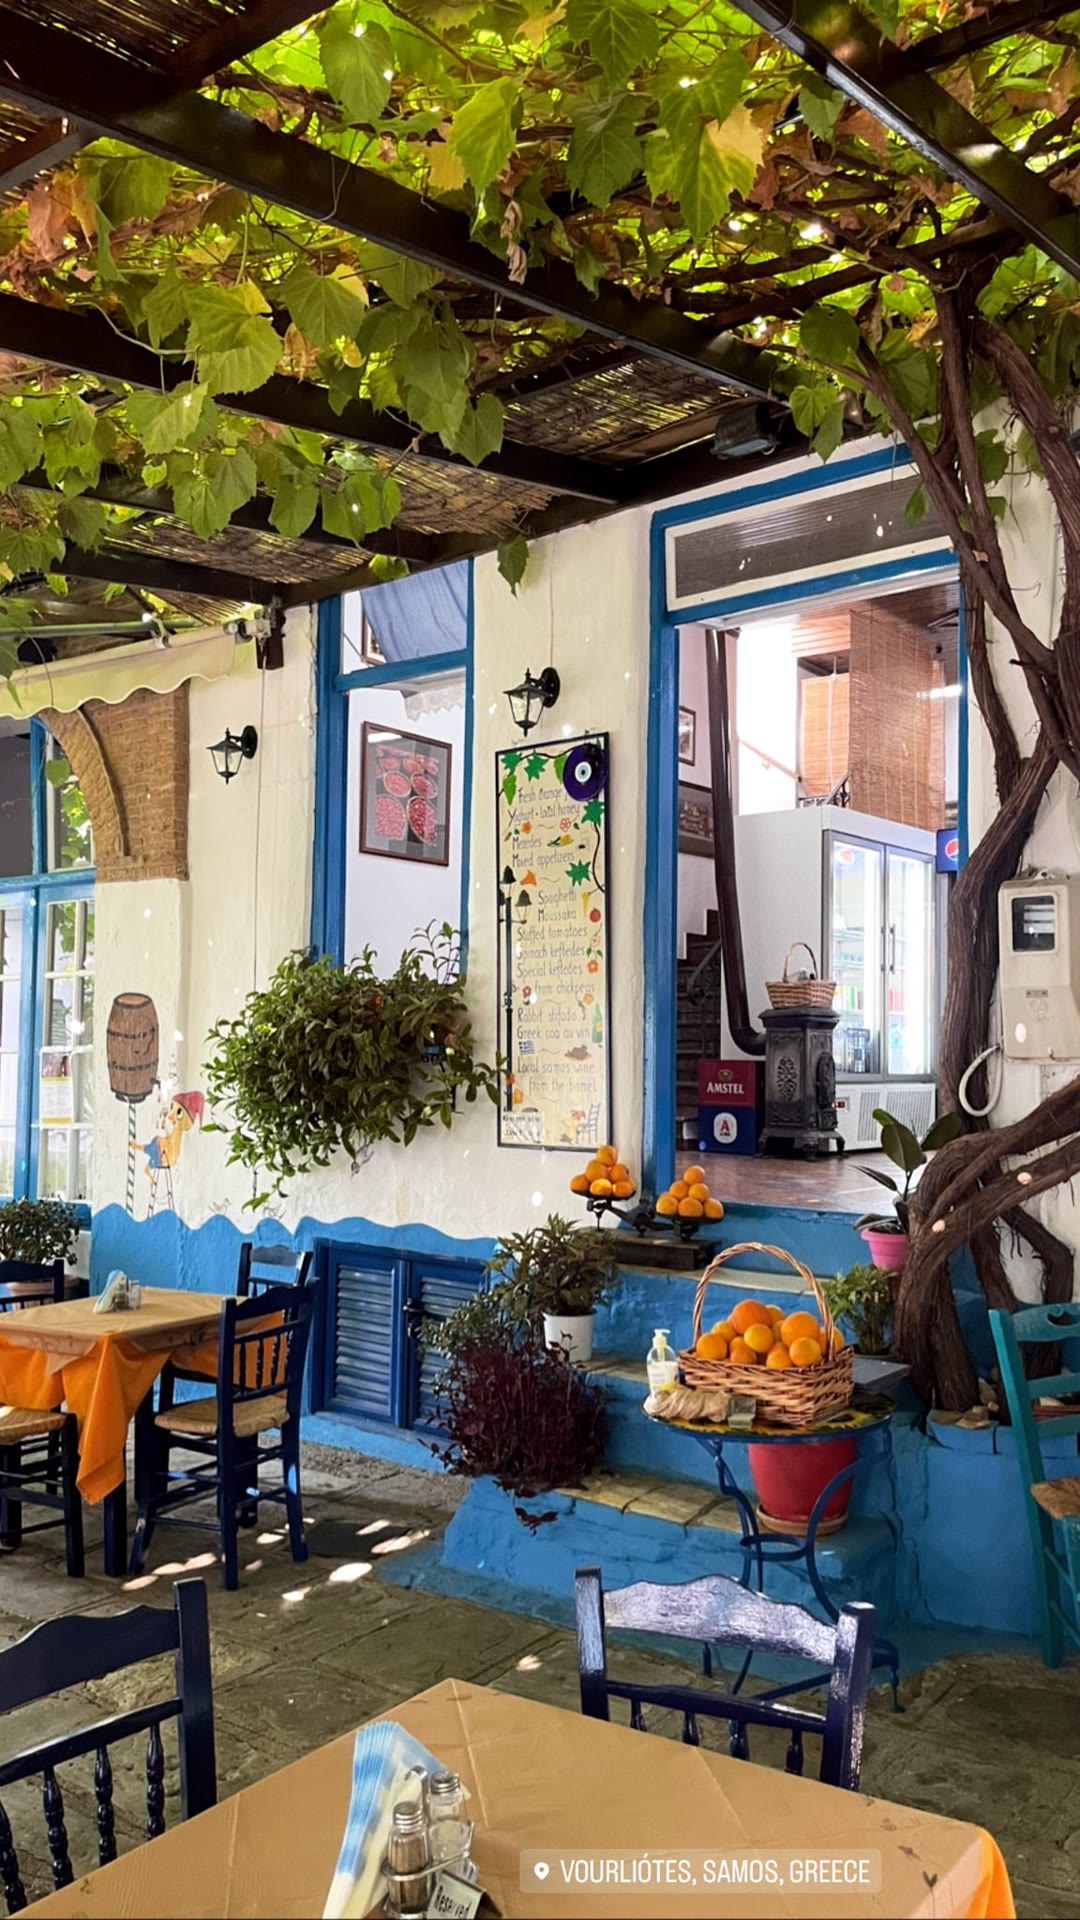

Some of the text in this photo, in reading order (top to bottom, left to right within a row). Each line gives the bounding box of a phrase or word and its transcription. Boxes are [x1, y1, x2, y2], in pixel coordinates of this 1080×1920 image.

[518, 786, 536, 804] Fresh
[558, 803, 580, 819] honey
[512, 834, 542, 850] Mezedes
[512, 849, 575, 869] Mixed appetizers
[538, 888, 576, 907] Spaghetti
[538, 908, 576, 922] Moussaka
[517, 923, 588, 944] Stuffed tomatoes
[550, 942, 585, 959] keftedes
[517, 960, 583, 980] Special keftedes
[535, 979, 595, 997] from chickpeas
[517, 1006, 577, 1025] Rabbit stifado
[517, 1025, 541, 1039] Greek
[563, 1029, 573, 1039] au
[576, 1027, 590, 1039] vin
[517, 1056, 539, 1074] Local
[574, 1062, 595, 1074] wine
[529, 1076, 597, 1096] from the barrel
[707, 1082, 744, 1094] AMSTEL
